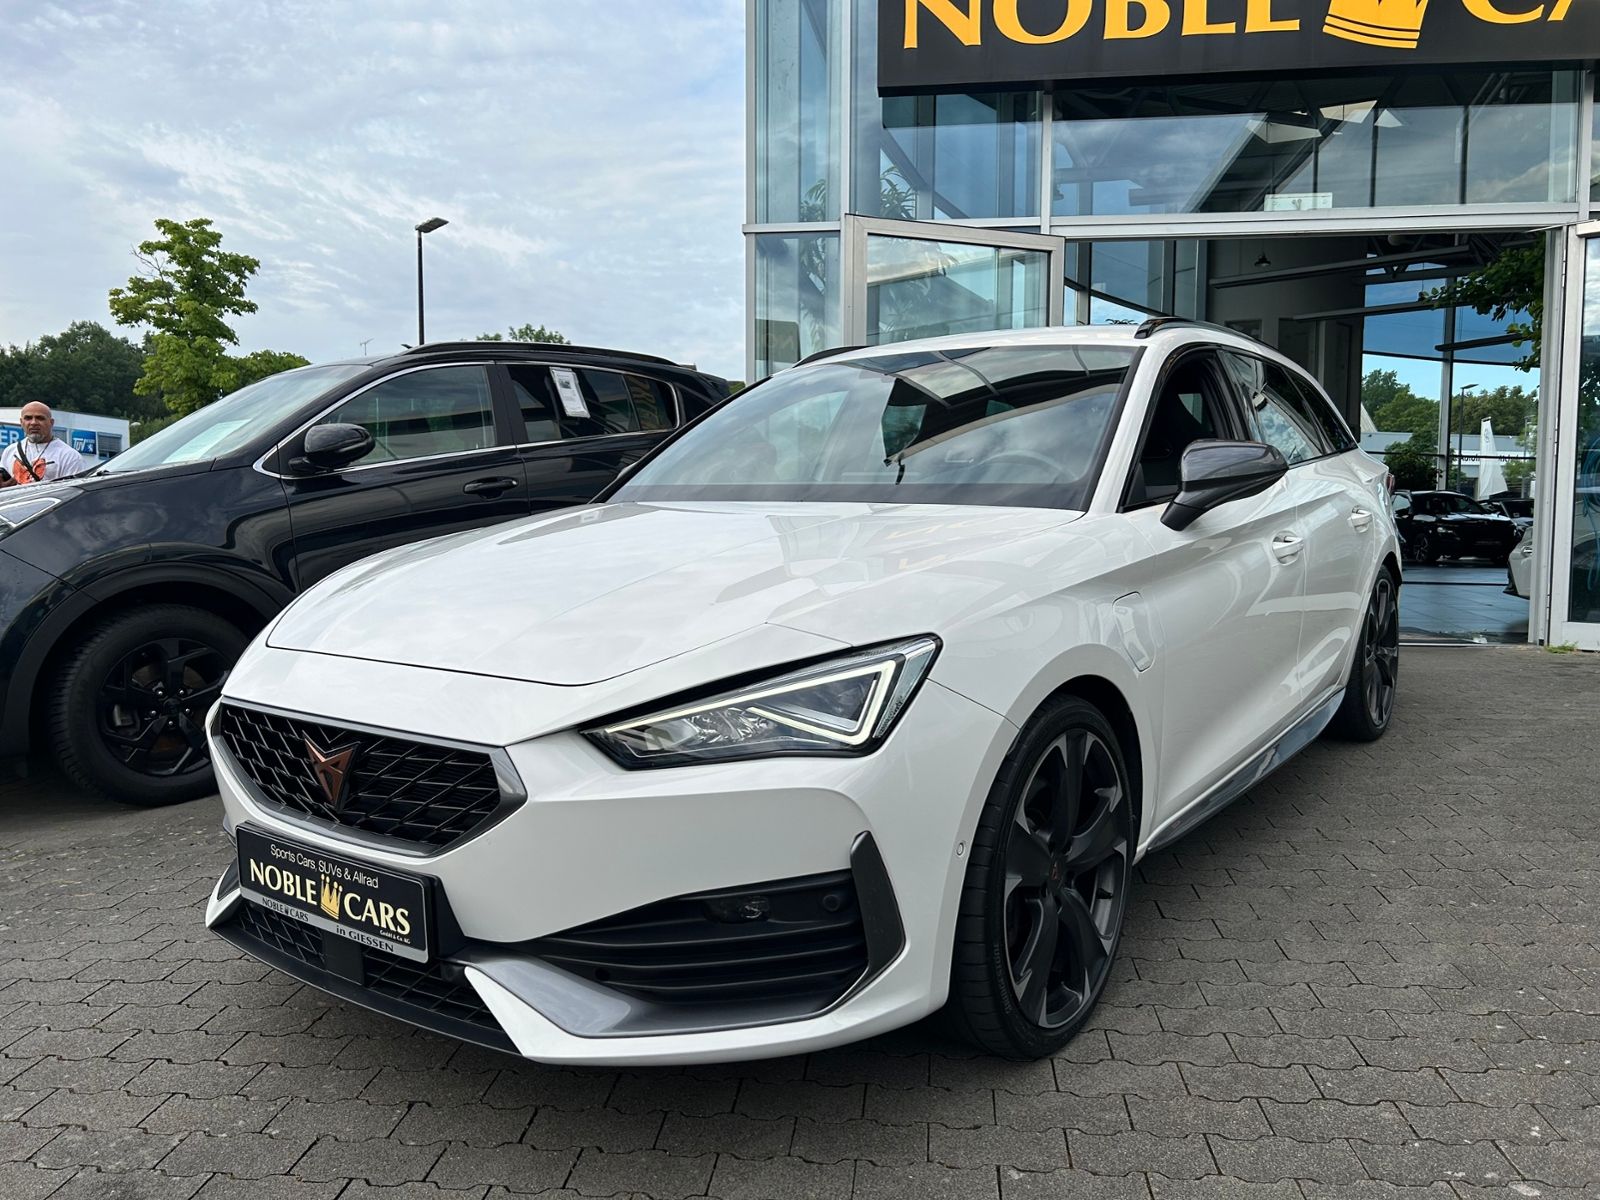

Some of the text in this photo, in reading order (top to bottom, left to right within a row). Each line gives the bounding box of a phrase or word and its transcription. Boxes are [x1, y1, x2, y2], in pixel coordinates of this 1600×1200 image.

[270, 844, 379, 889] Sports Cars, SUVs & Allrad
[249, 858, 411, 935] NOBLE CARS
[262, 897, 309, 922] NOBLE CARS
[336, 924, 394, 952] in GIESSEN
